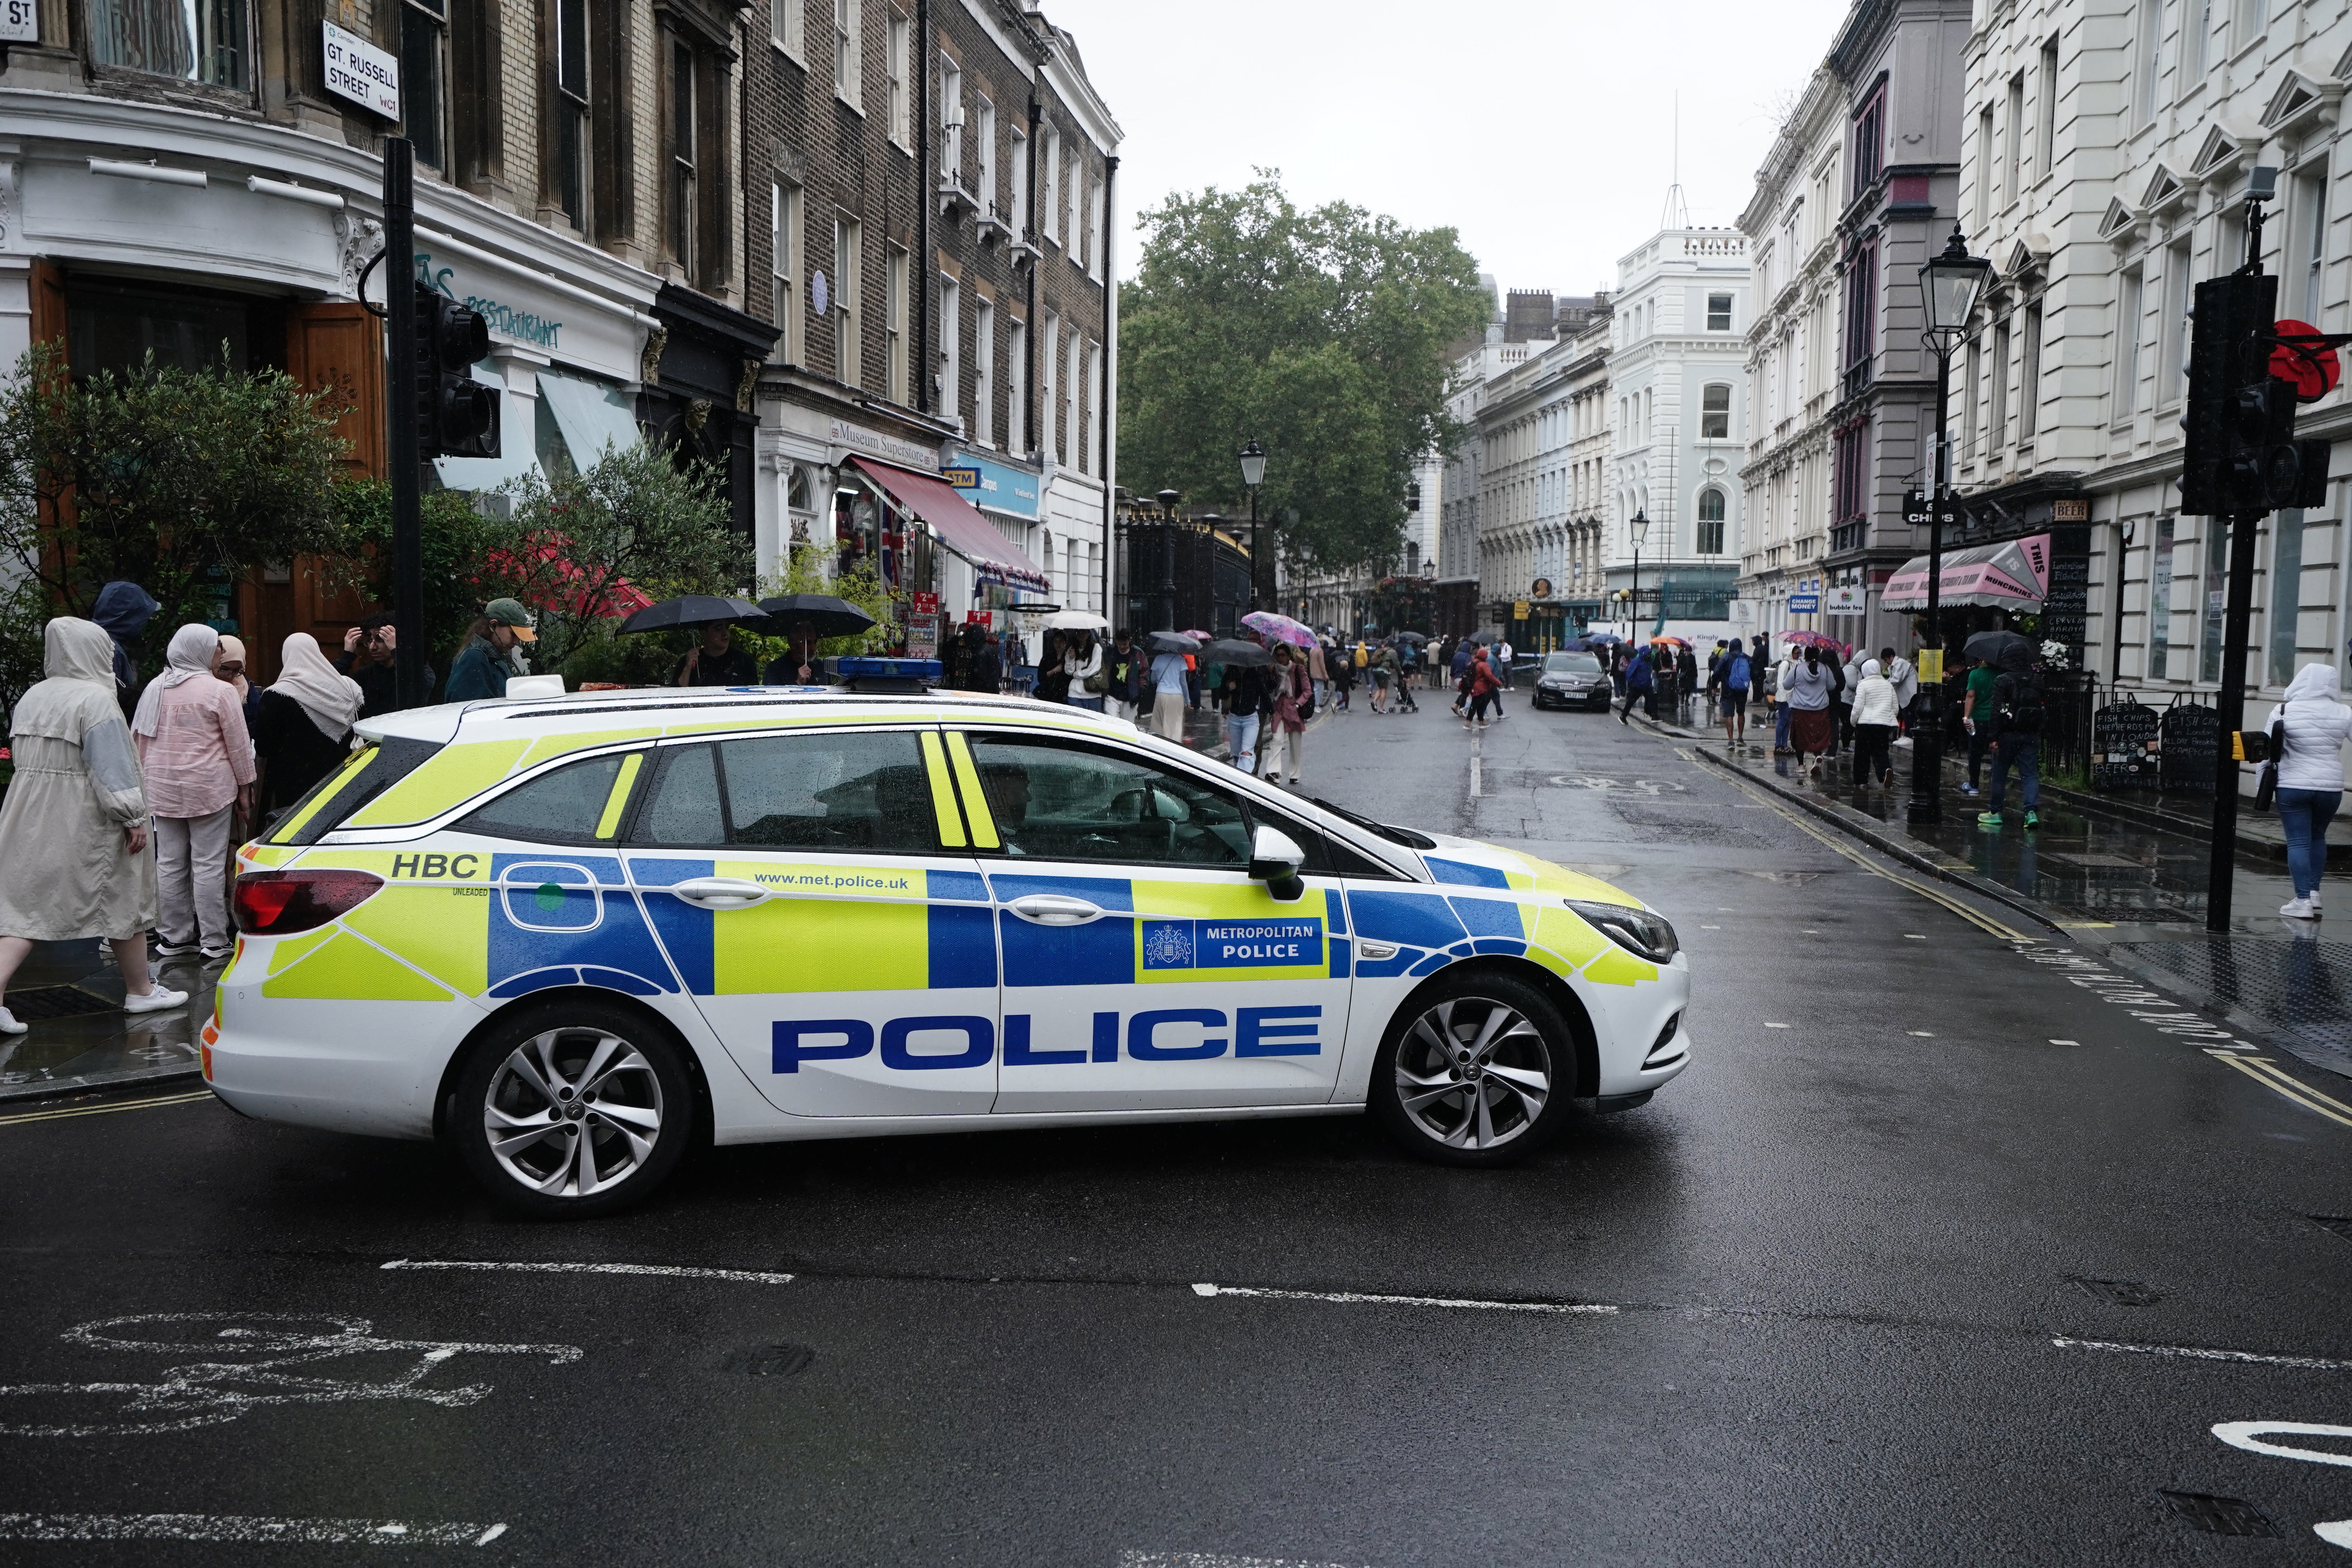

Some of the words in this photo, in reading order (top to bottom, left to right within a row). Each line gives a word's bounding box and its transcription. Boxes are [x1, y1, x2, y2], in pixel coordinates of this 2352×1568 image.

[338, 33, 355, 45] Camden
[328, 43, 345, 65] GT.
[350, 53, 396, 90] RUSSELL
[330, 67, 370, 99] STREET
[379, 94, 396, 112] WC1
[840, 423, 879, 449] Museum
[881, 436, 924, 463] Superstore
[947, 473, 971, 483] ATM
[2058, 506, 2084, 516] BEER
[1908, 514, 1954, 522] CHIS
[2005, 557, 2020, 571] IS
[2031, 543, 2045, 573] THIS
[1985, 575, 2033, 598] MUNCHKINS
[920, 593, 933, 602] £2.99
[916, 603, 921, 612] 2
[929, 604, 936, 613] £5
[973, 612, 987, 621] £1.99
[2110, 704, 2136, 713] BEST
[2178, 706, 2203, 715] BEST
[2169, 716, 2199, 730] FISH
[2121, 731, 2159, 741] LONDON
[2095, 764, 2129, 774] BEER
[392, 854, 479, 878] HBC
[754, 874, 908, 889] www.met.police.uk
[453, 888, 488, 897] UNLEADED
[1207, 926, 1313, 939] METROPOLITAN
[1223, 944, 1299, 958] POLICE
[772, 1005, 1322, 1074] POLICE
